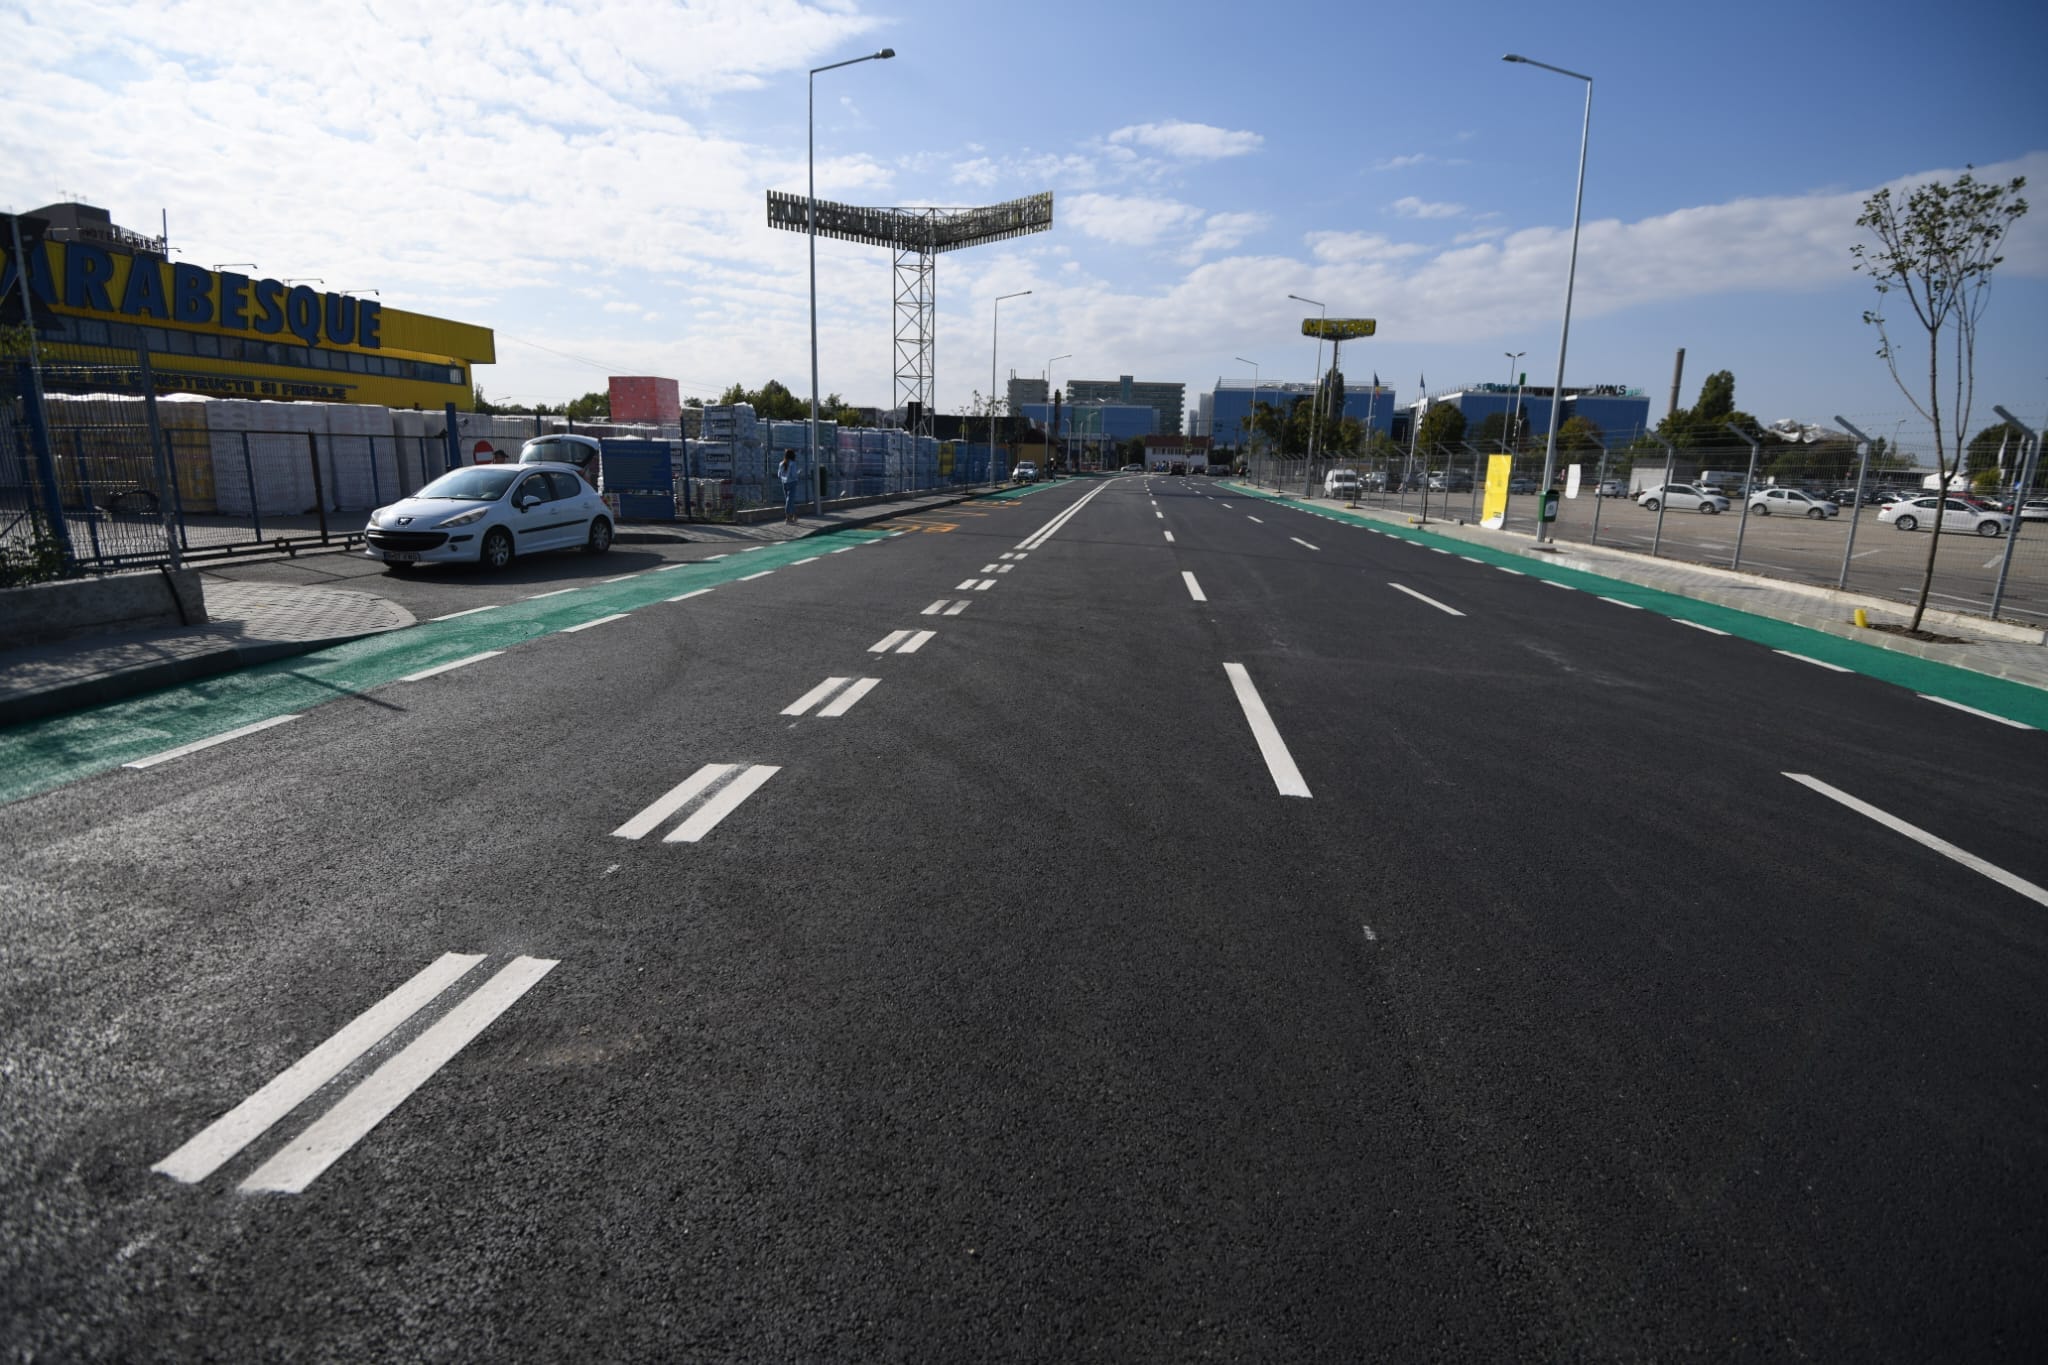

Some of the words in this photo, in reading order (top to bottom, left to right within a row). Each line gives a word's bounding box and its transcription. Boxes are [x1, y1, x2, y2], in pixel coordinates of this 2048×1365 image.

[0, 237, 381, 349] ARABESQUE
[1303, 319, 1375, 336] METRO
[1595, 384, 1627, 396] WNS
